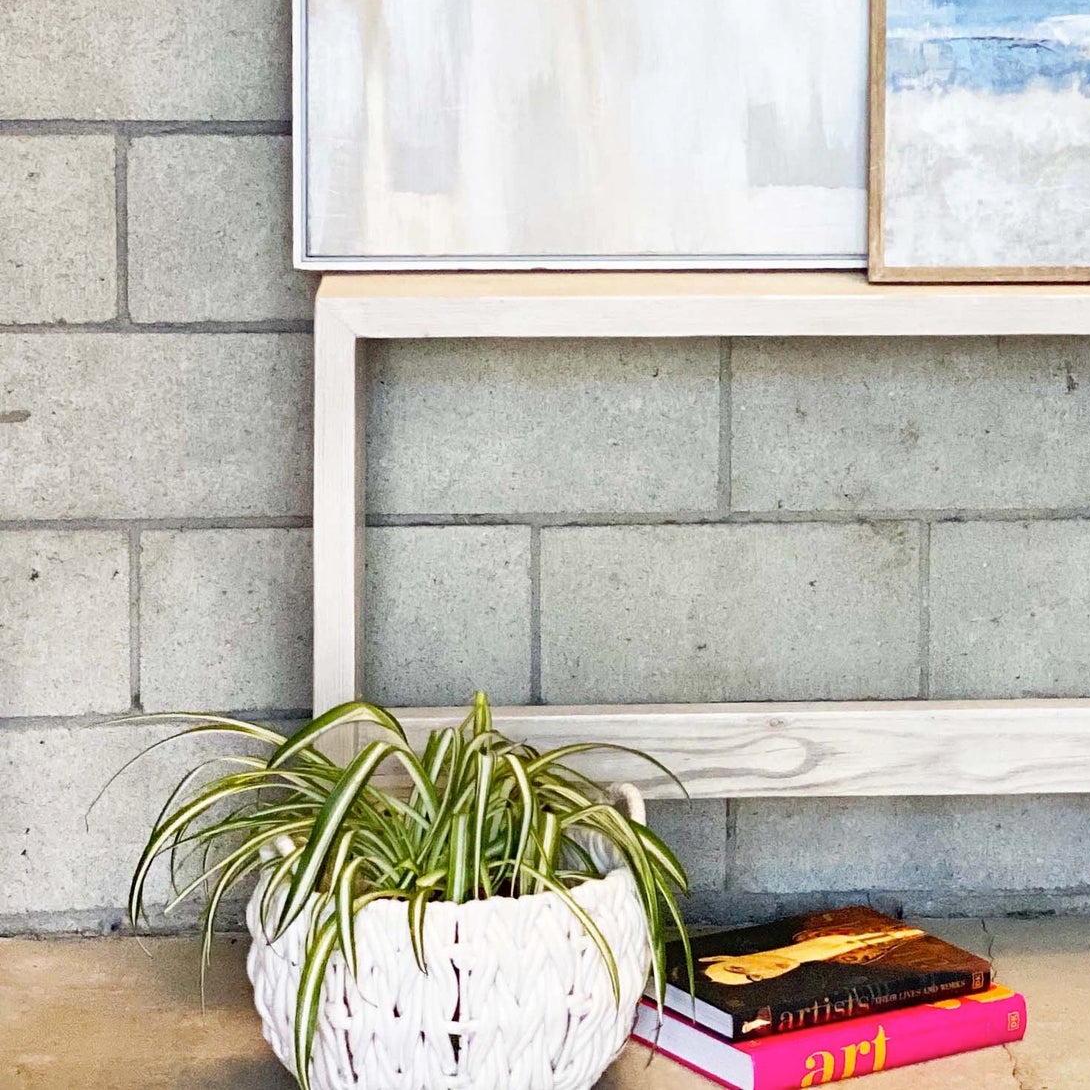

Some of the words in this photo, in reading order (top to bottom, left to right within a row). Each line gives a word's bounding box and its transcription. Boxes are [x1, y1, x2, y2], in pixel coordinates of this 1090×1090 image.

[778, 990, 868, 1029] artists
[899, 990, 921, 1000] LIVES
[923, 985, 939, 995] AND
[940, 980, 967, 991] WORKS
[801, 1025, 890, 1087] art
